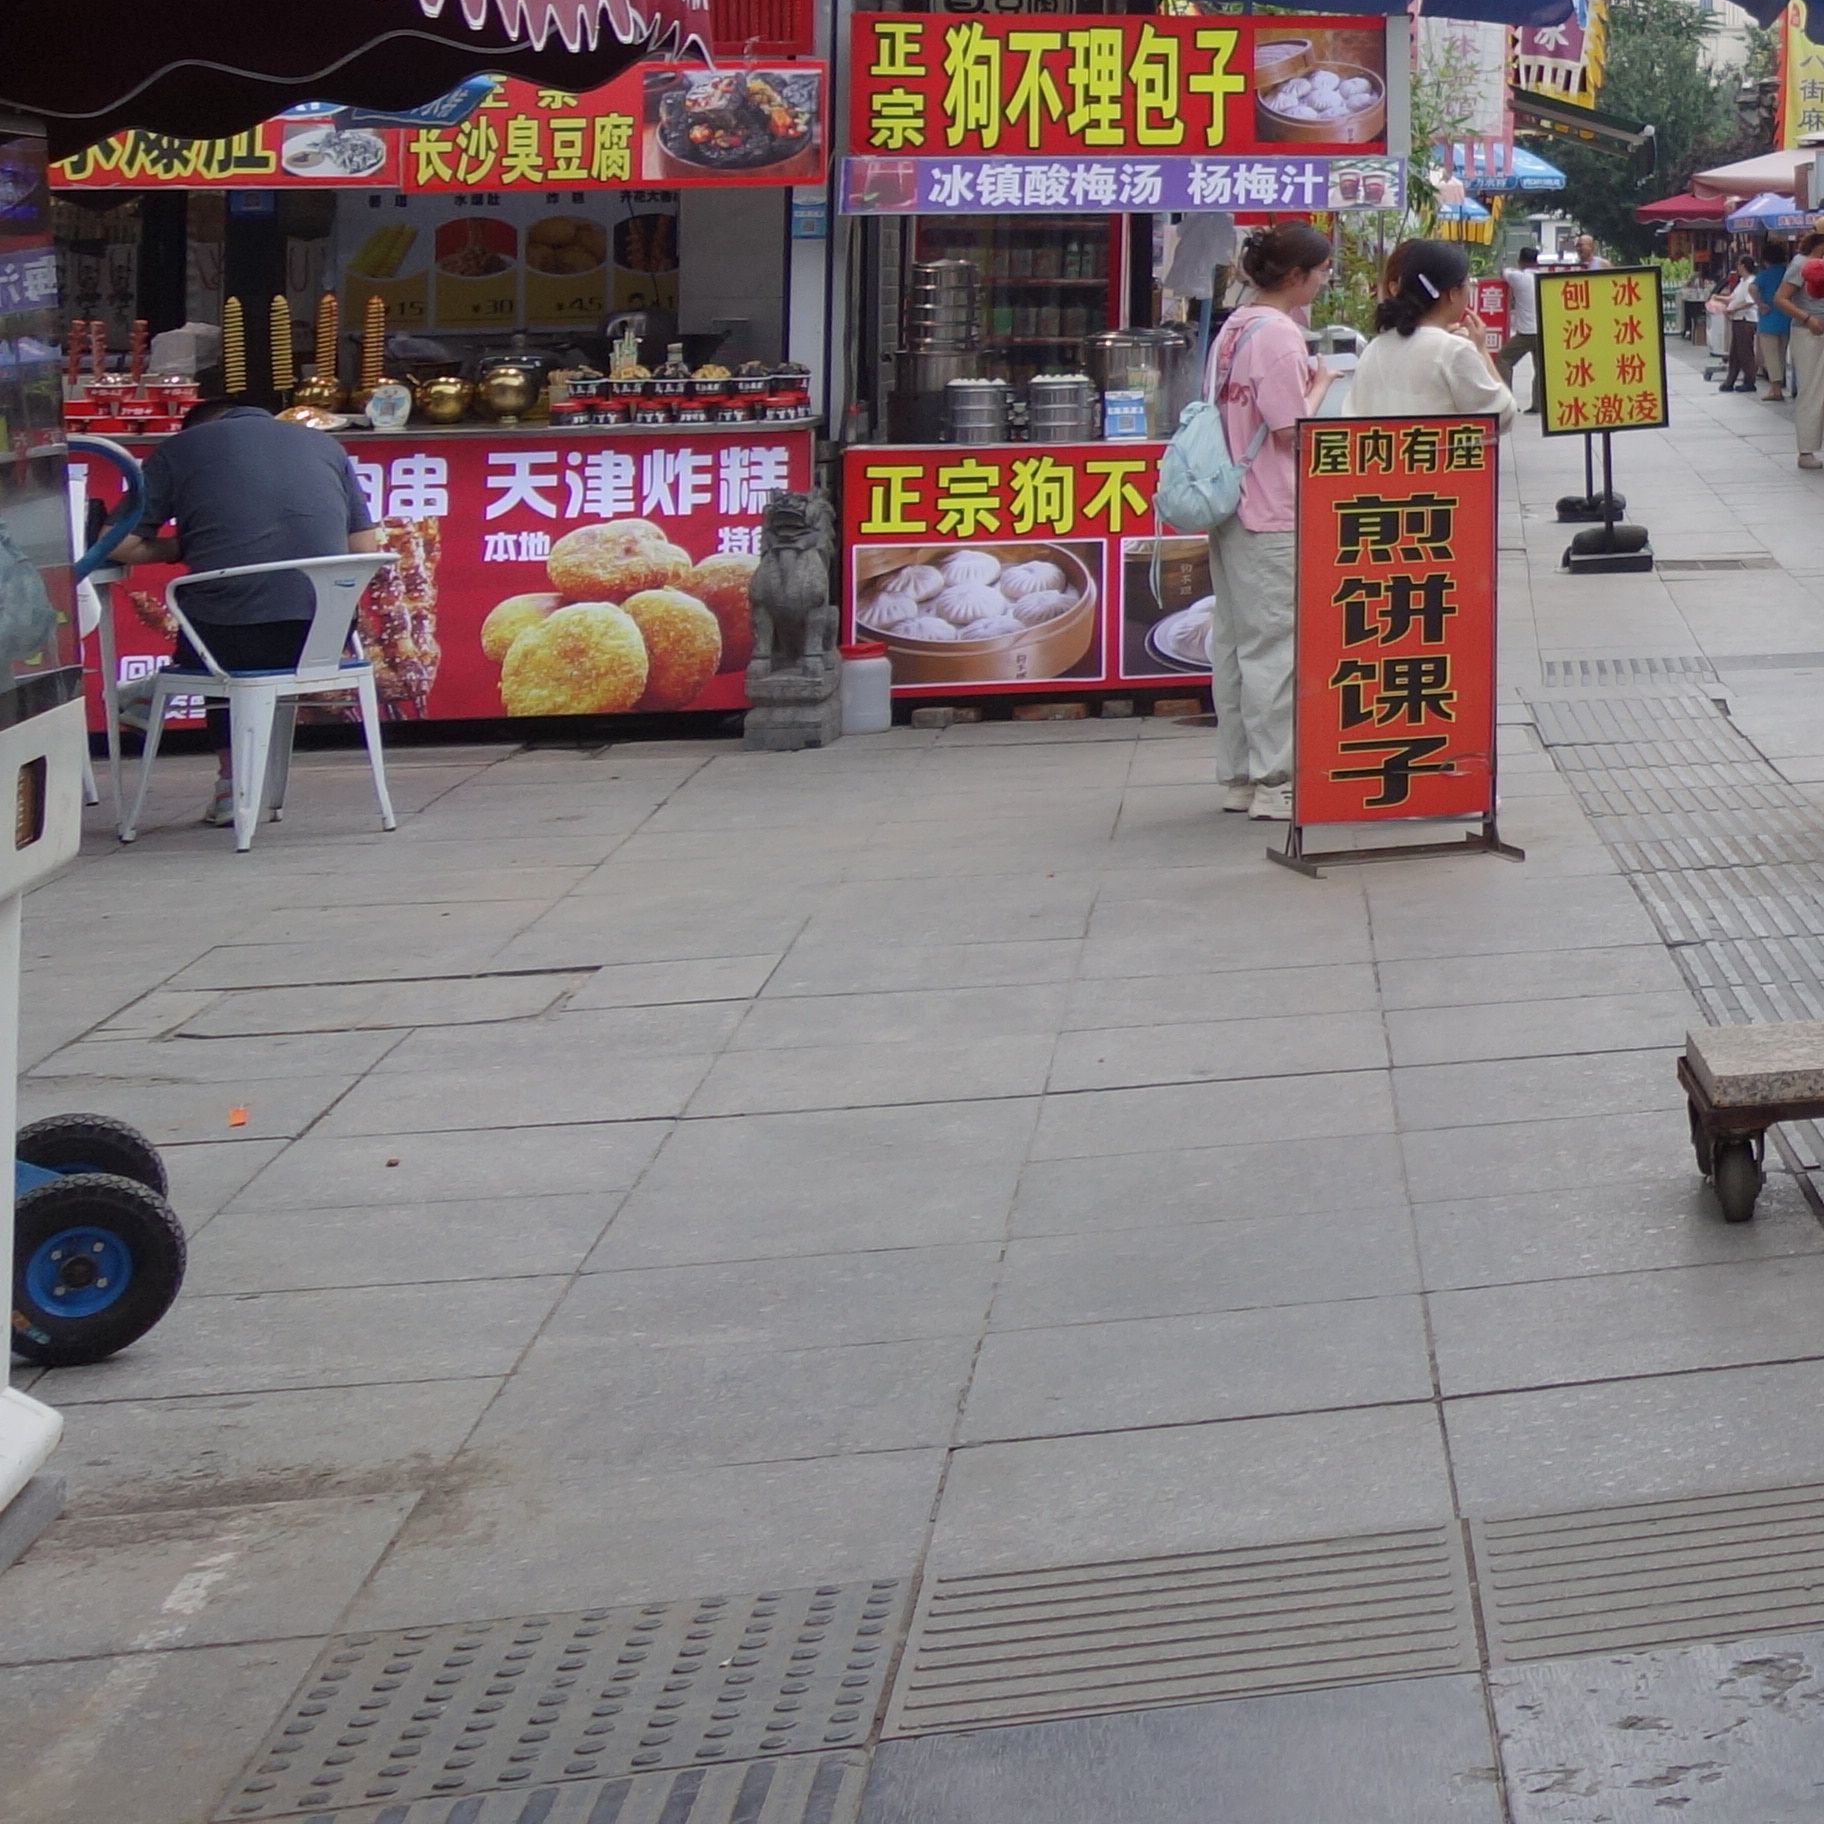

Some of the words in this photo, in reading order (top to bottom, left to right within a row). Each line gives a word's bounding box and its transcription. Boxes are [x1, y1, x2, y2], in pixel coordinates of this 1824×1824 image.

[870, 22, 926, 149] 正宗
[944, 24, 1246, 153] 狗不理包子
[408, 112, 634, 186] 长沙臭豆腐
[928, 159, 1164, 208] 冰镇酸梅汤
[1186, 159, 1324, 208] 杨梅汁
[1562, 276, 1641, 312] 刨冰
[1563, 315, 1643, 350] 沙冰
[1565, 352, 1646, 388] 冰粉
[1557, 390, 1658, 427] 冰激凌
[1309, 428, 1488, 475] 屋内有座
[485, 446, 790, 520] 天津炸糕
[858, 460, 1164, 538] 正宗狗不
[482, 531, 551, 563] 本地
[1331, 490, 1457, 809] 煎饼馃子
